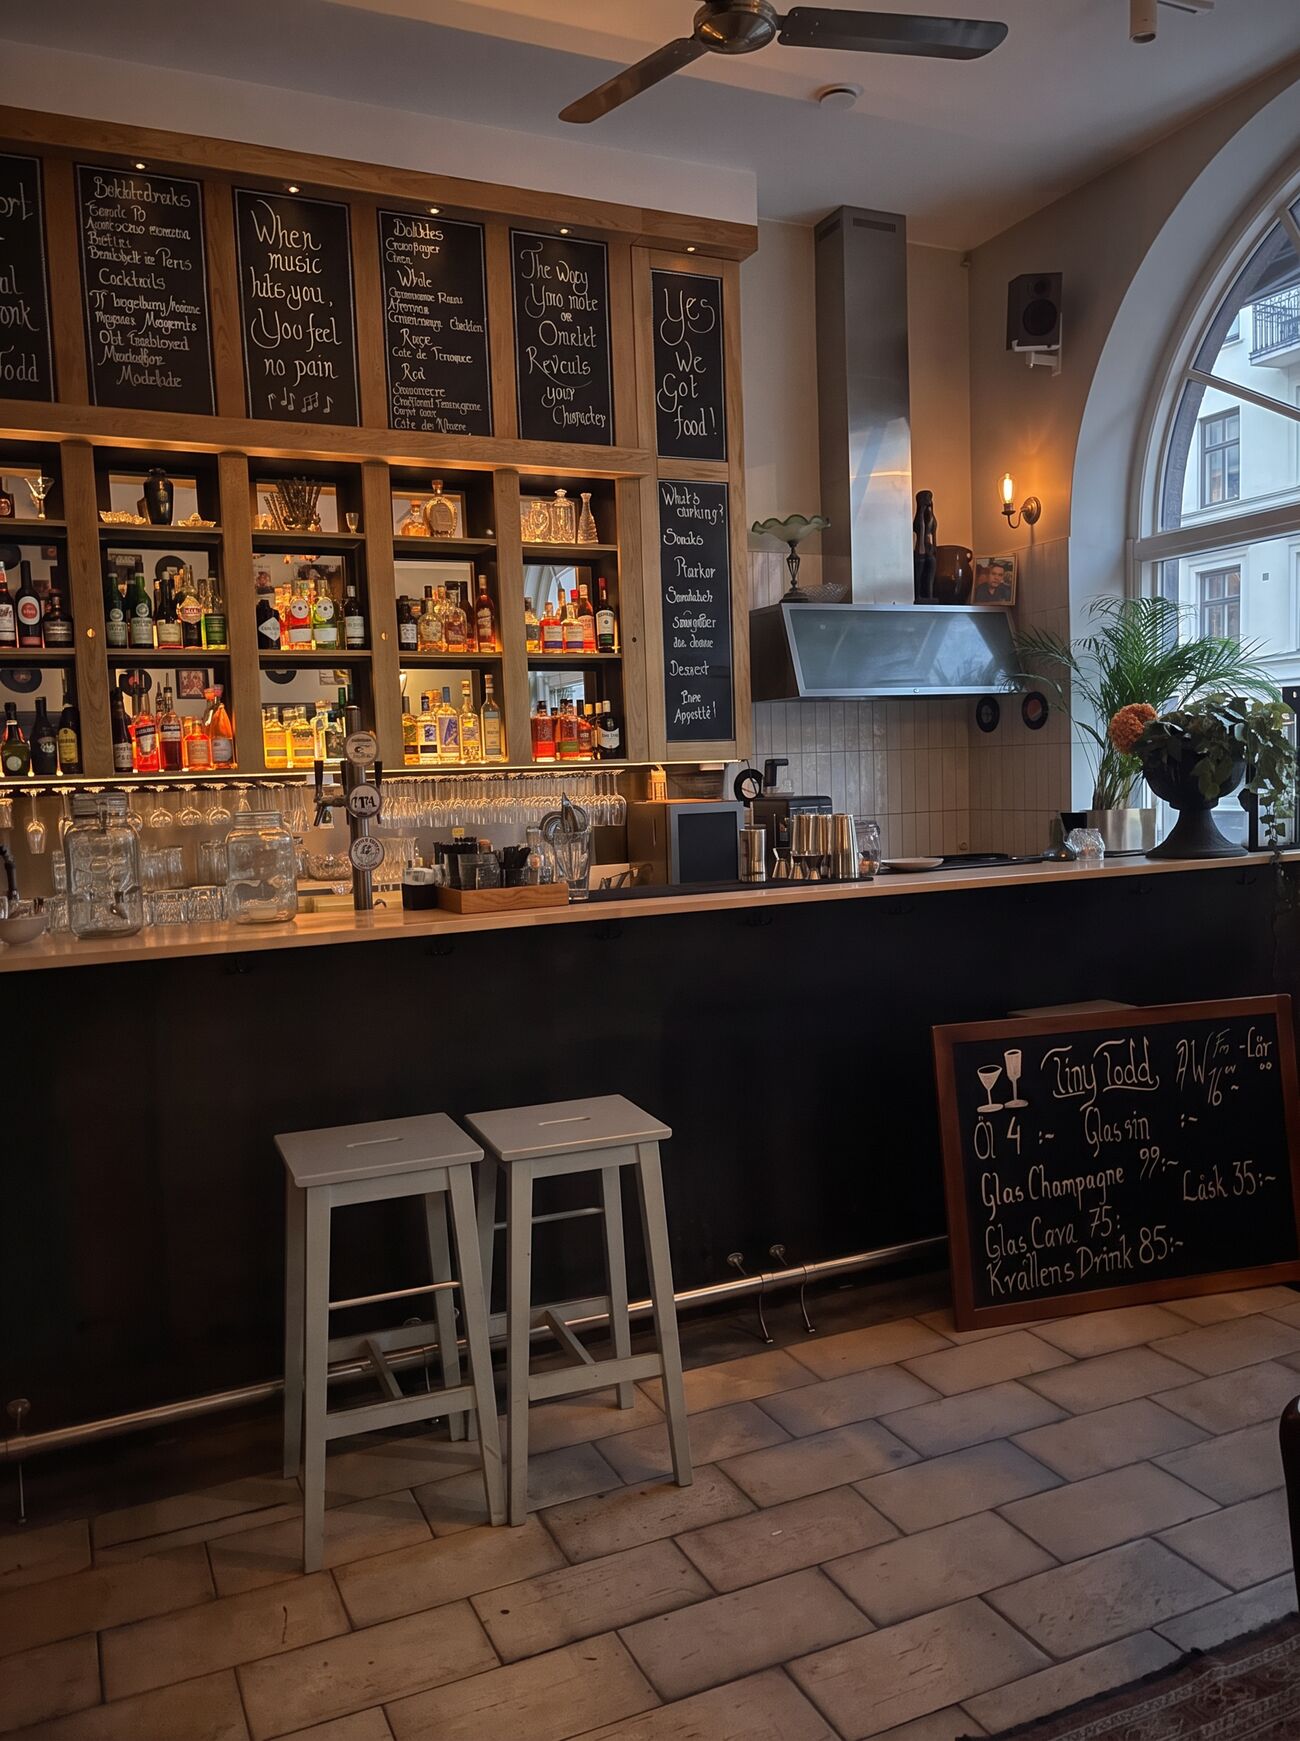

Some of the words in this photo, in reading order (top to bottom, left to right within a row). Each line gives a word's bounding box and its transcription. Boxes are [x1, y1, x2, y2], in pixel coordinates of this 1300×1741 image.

[0, 182, 33, 221] ort
[250, 199, 322, 251] When
[99, 268, 166, 290] Cocktails
[250, 266, 286, 299] hits
[267, 252, 323, 275] music
[520, 241, 553, 280] The
[250, 307, 303, 349] You
[306, 313, 343, 352] feel
[660, 287, 715, 346] Yes
[263, 358, 286, 377] no
[292, 354, 339, 387] pain
[675, 340, 707, 374] We
[656, 372, 700, 413] Got
[1041, 1045, 1097, 1111] Tiny
[1093, 1036, 1160, 1092] Todd
[973, 1115, 996, 1160] Öl
[1006, 1116, 1022, 1155] 4
[1084, 1106, 1122, 1158] Glas
[981, 1171, 1024, 1221] Glas
[1028, 1163, 1125, 1211] Champagne
[985, 1223, 1028, 1264] Glas
[1031, 1216, 1079, 1250] Cava
[1076, 1234, 1135, 1278] Drink
